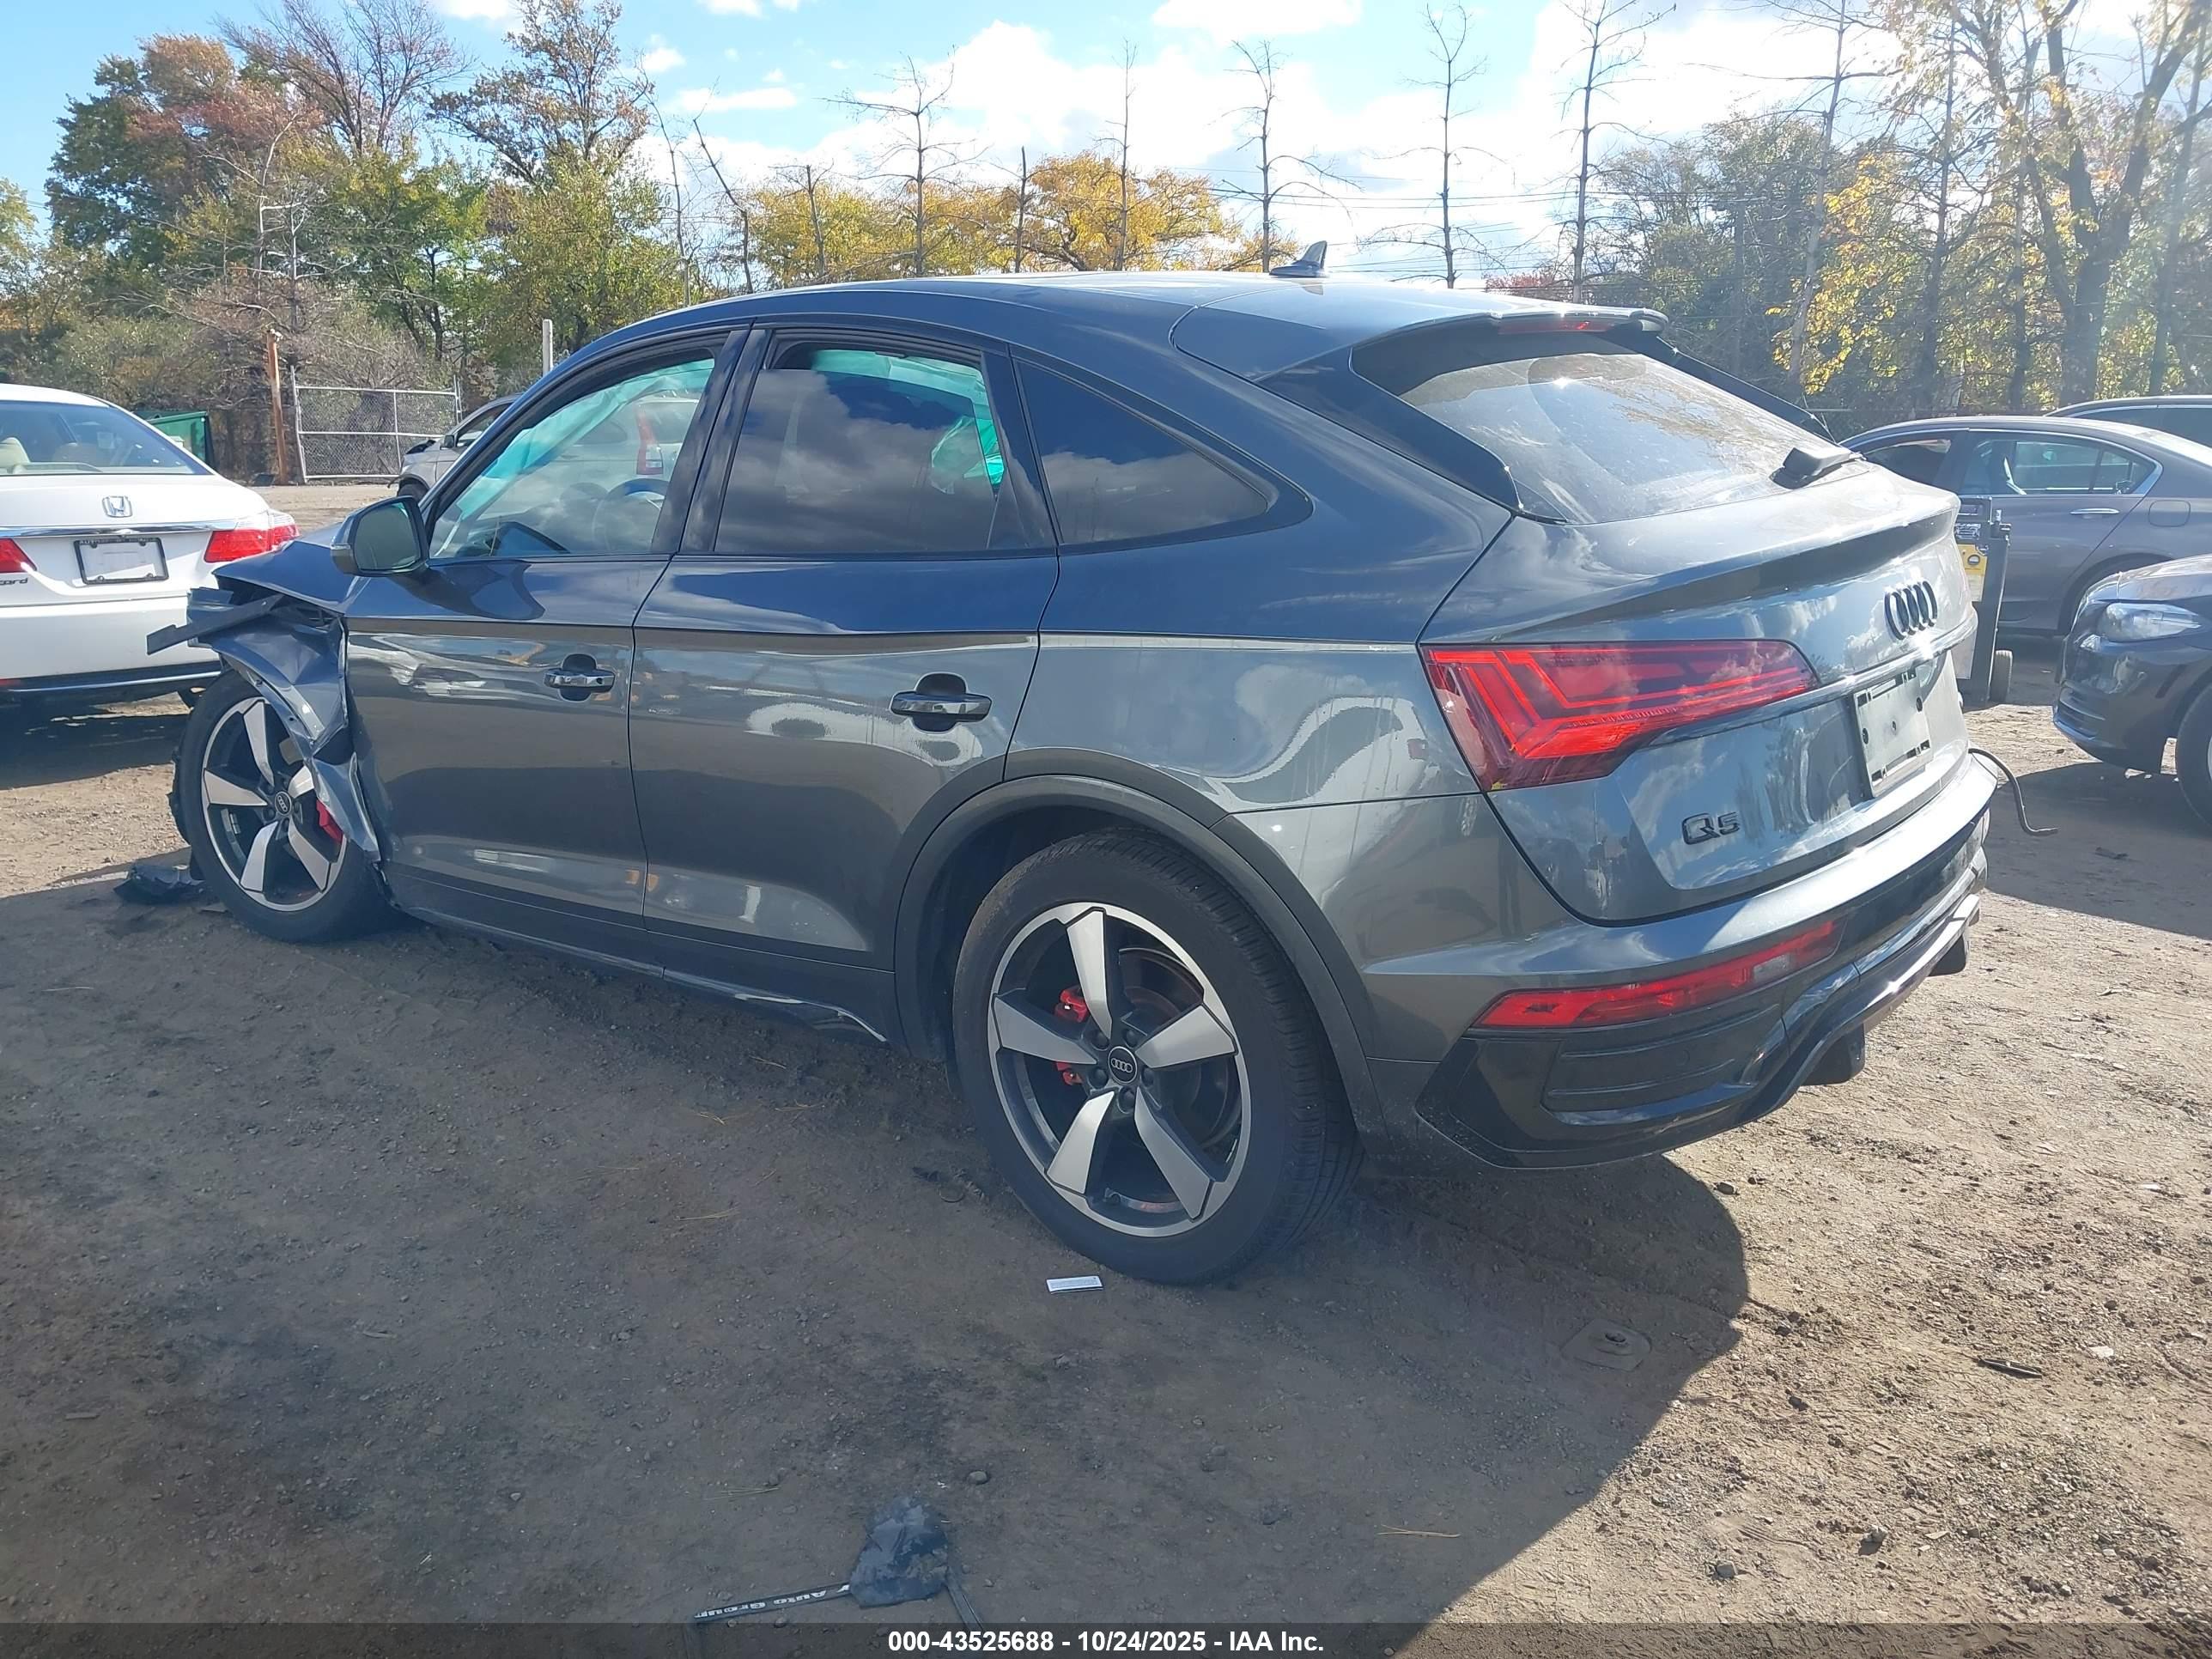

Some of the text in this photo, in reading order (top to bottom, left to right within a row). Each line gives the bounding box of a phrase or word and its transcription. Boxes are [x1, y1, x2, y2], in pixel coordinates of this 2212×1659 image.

[1681, 811, 1740, 845] Q5
[693, 1589, 828, 1619] Auto Group
